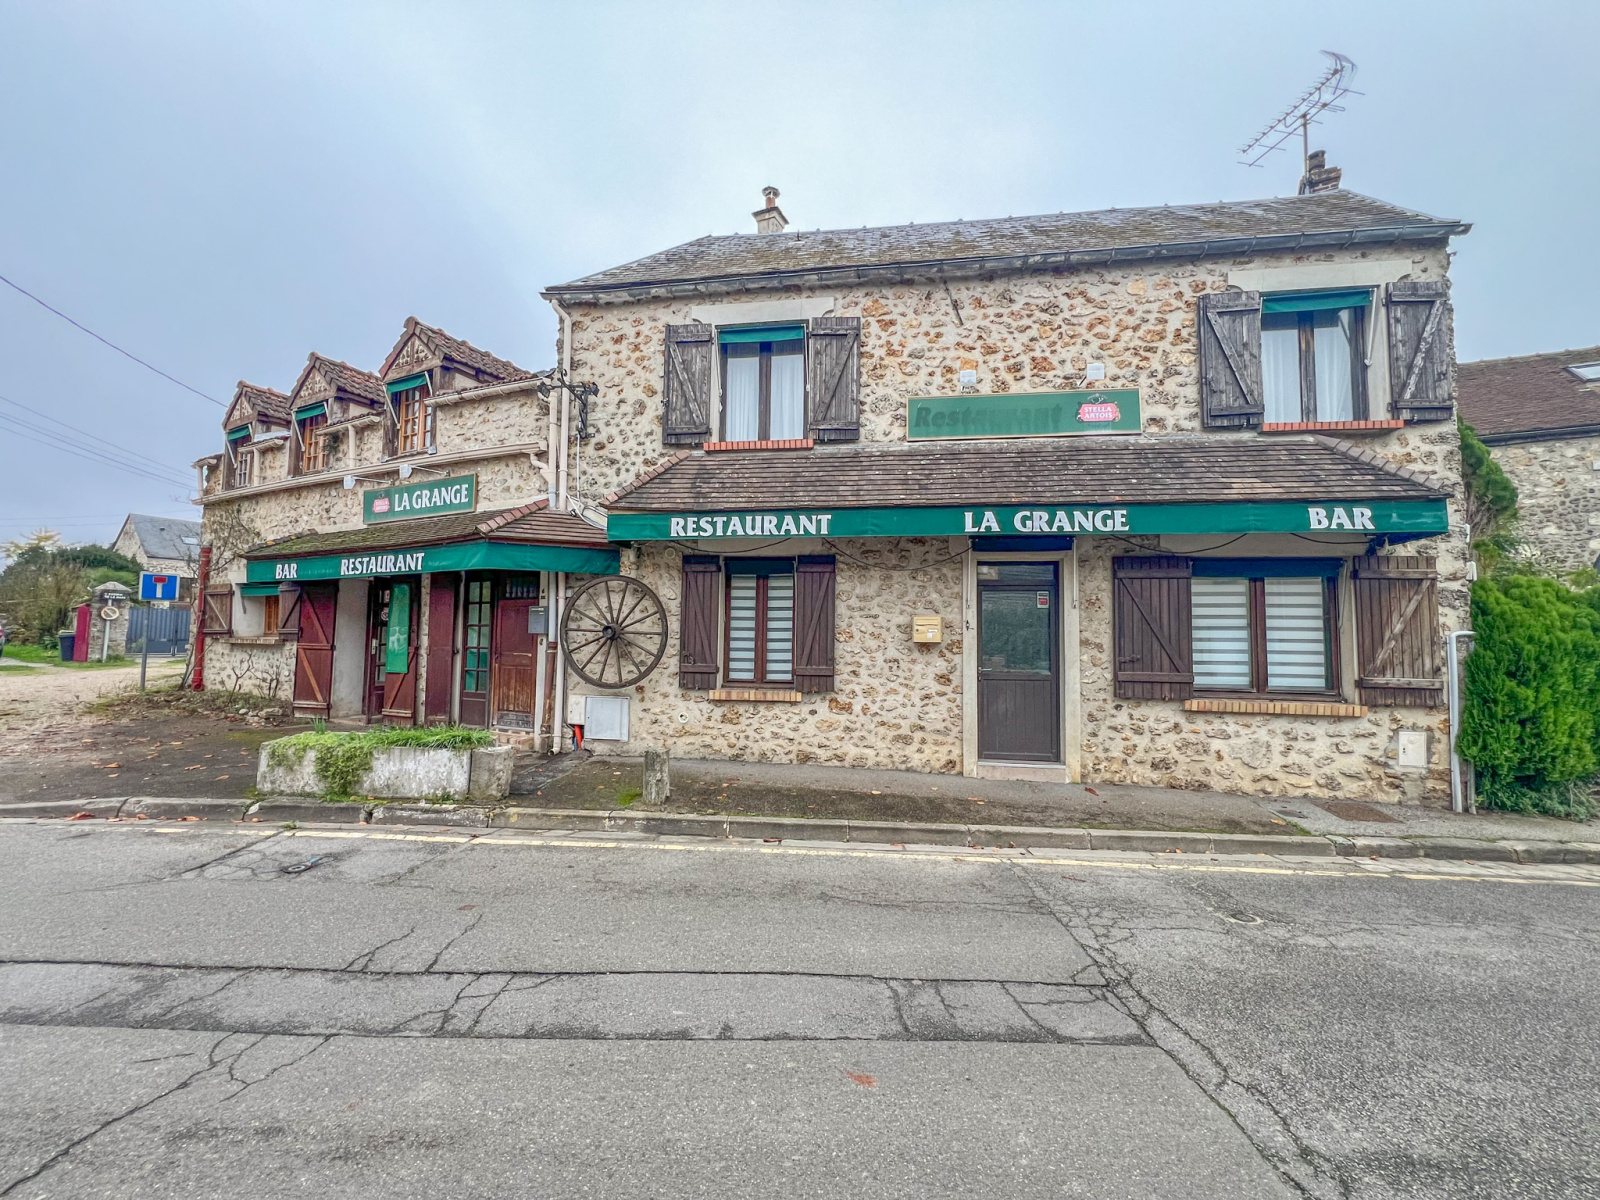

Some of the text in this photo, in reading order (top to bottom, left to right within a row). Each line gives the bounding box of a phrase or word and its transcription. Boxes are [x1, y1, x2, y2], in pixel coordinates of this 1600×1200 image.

[394, 493, 410, 511] LA
[412, 484, 469, 509] GRANGE
[670, 514, 832, 537] RESTAURANT
[964, 510, 1129, 532] LA GRANGE
[1308, 507, 1375, 529] BAR
[275, 563, 297, 579] BAR
[340, 553, 425, 576] RESTAURANT
